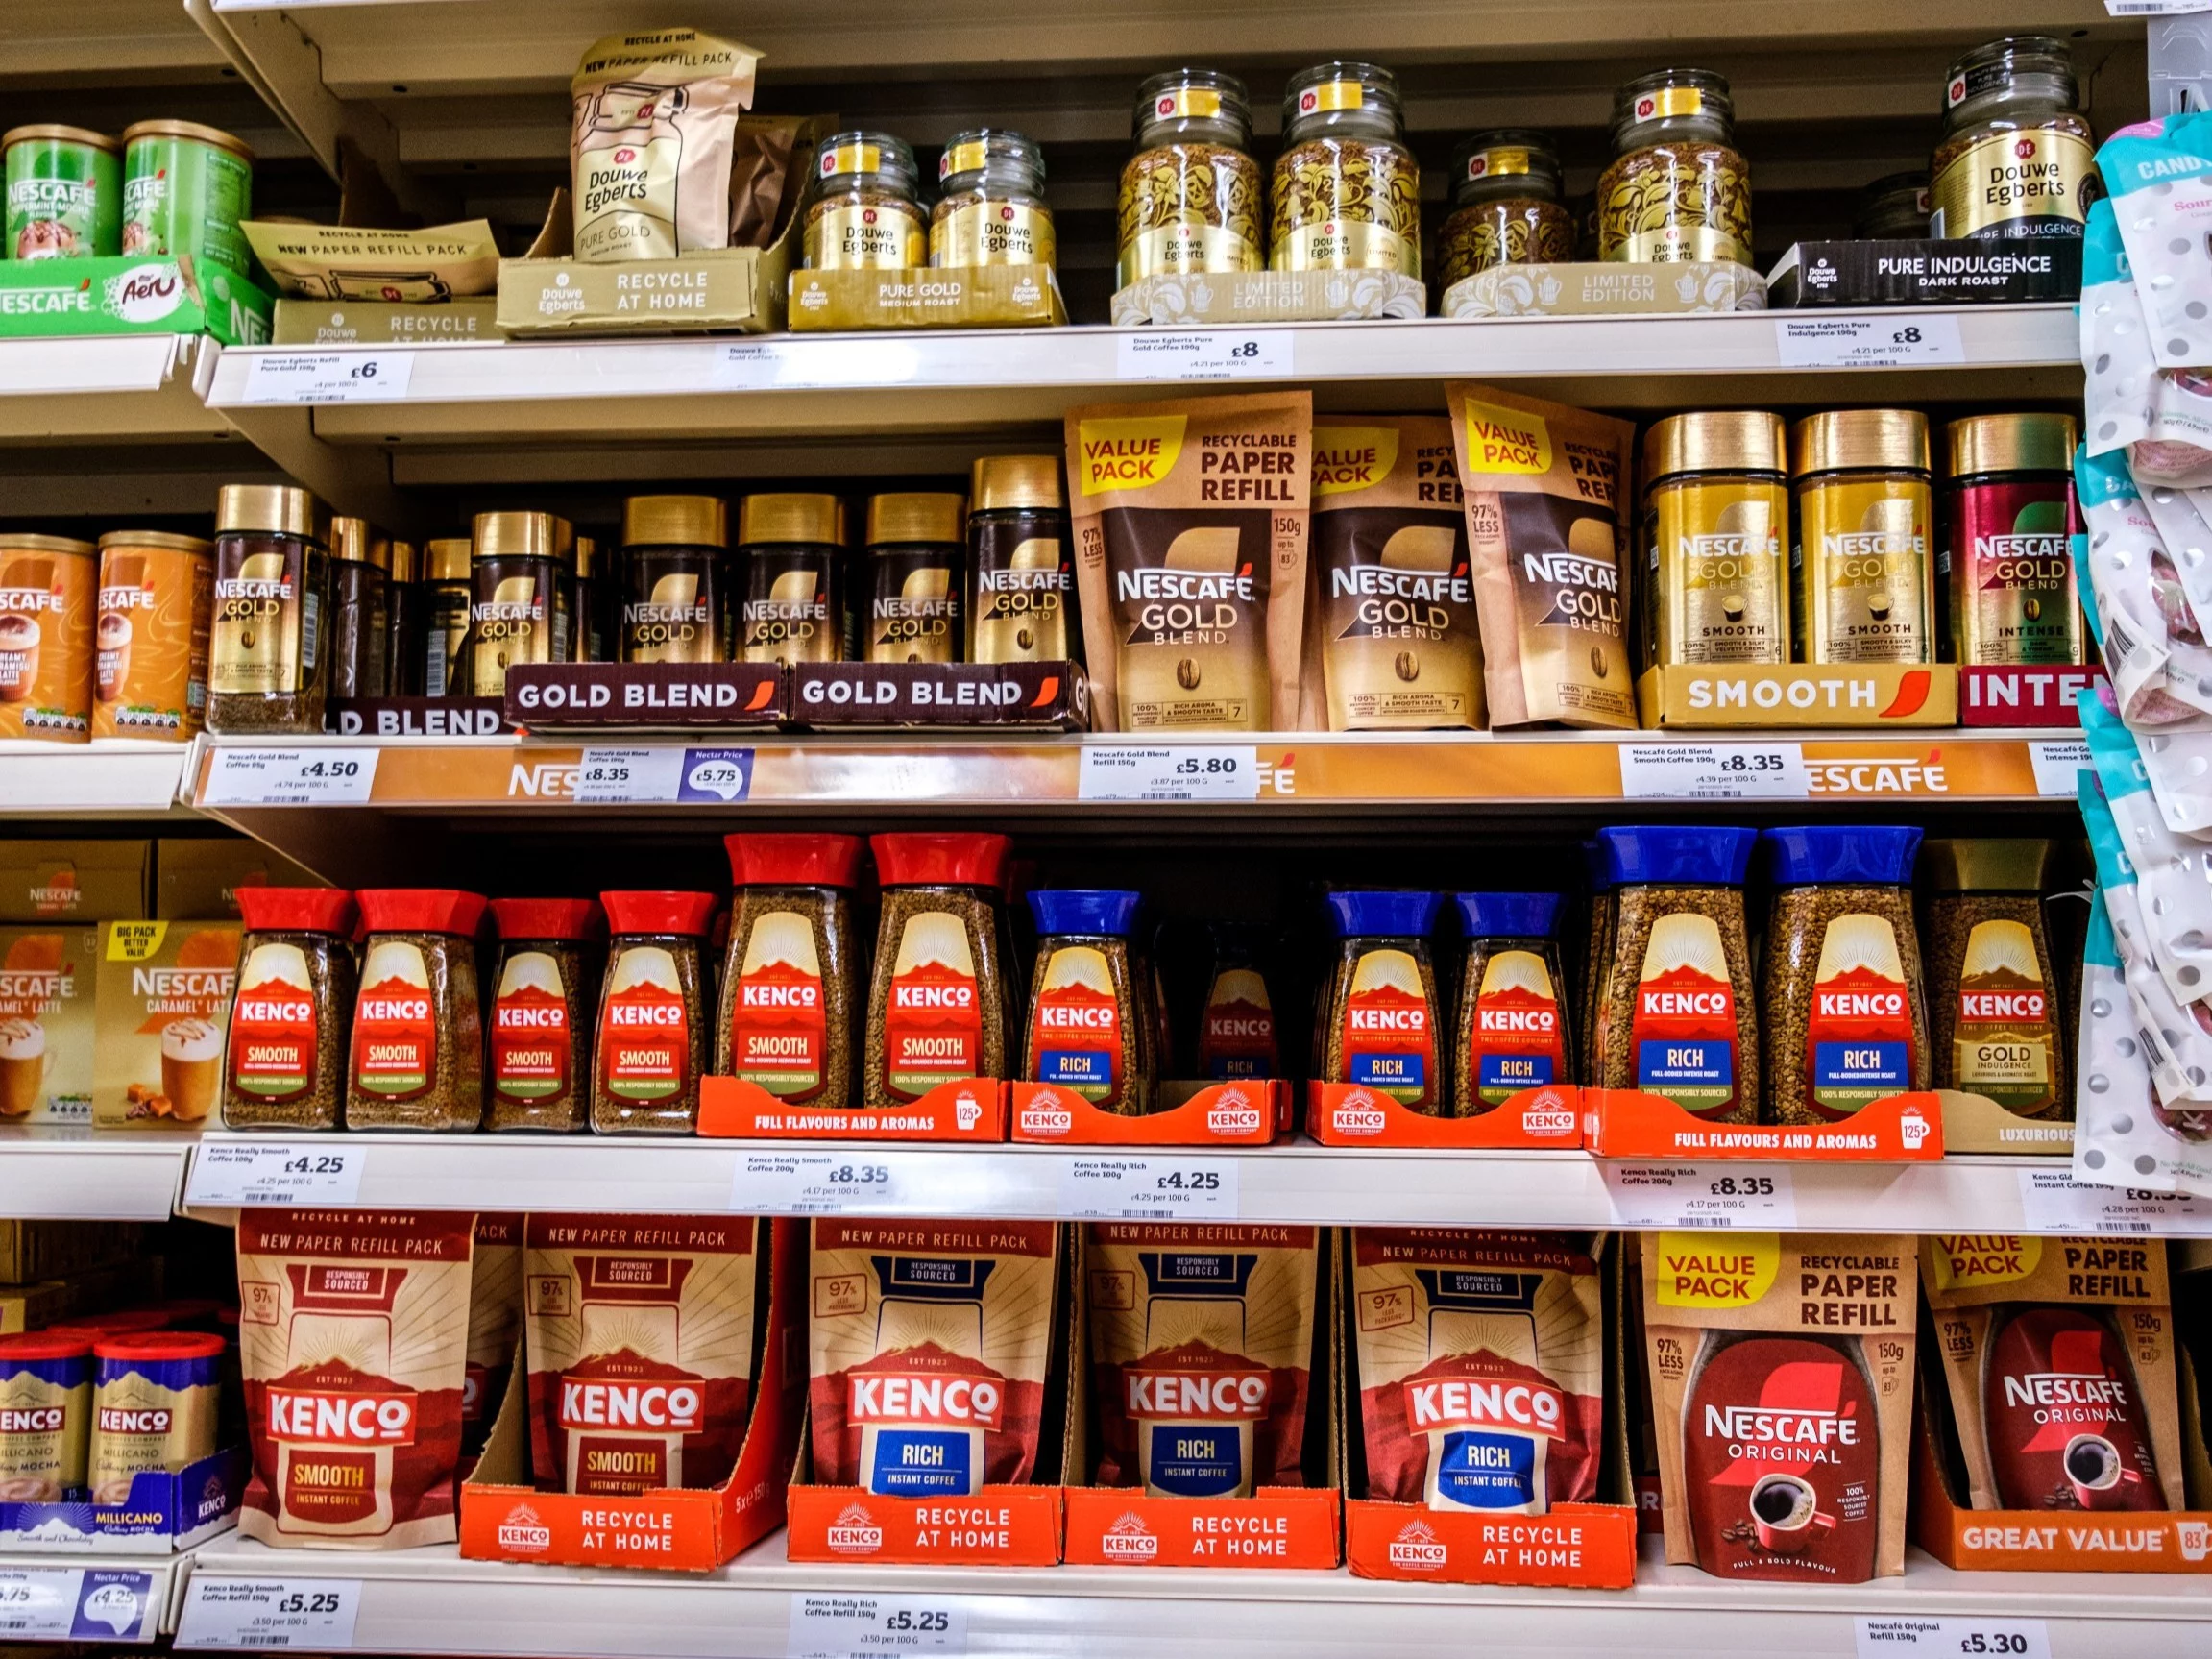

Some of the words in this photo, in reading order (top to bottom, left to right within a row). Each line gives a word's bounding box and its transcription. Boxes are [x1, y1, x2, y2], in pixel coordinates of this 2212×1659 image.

[590, 168, 648, 189] Douwe
[1991, 161, 2059, 183] Douwe
[8, 179, 96, 205] NESCAFÉ
[585, 183, 646, 213] Egberts
[1986, 178, 2065, 206] Egberts
[278, 244, 307, 256] NEW
[312, 245, 361, 256] PAPER
[368, 245, 421, 256] REFILL
[427, 245, 467, 256] PACK
[1879, 257, 1923, 274] PURE
[1931, 256, 2051, 274] INDULGENCE
[617, 272, 708, 289] RECYCLE
[1585, 276, 1653, 288] LIMITED
[1919, 277, 1957, 286] DARK
[1962, 276, 2008, 286] ROAST
[880, 284, 914, 298] PURE
[920, 283, 961, 298] GOLD
[1582, 288, 1655, 302] EDITION
[617, 295, 641, 310] AT
[649, 293, 707, 309] HOME
[880, 299, 920, 307] MEDIUM
[925, 298, 960, 306] ROAST
[1788, 329, 1835, 338] Indulgence
[1819, 323, 1849, 331] Egberts
[1893, 327, 1922, 344] £8
[1231, 342, 1259, 357] £8
[351, 361, 377, 379] £6
[1085, 438, 1162, 459] VALUE
[1202, 434, 1296, 448] RECYCLABLE
[1092, 459, 1155, 483] PACK
[1201, 452, 1295, 475] PAPER
[1202, 479, 1295, 501] REFILL
[1274, 517, 1300, 535] 150g
[1679, 526, 1781, 558] NESCAFÉ
[980, 562, 1071, 593] NESCAFÉ
[1996, 560, 2066, 580] GOLD
[215, 574, 293, 599] NESCAFÉ
[1117, 563, 1255, 602] NESCAFÉ
[2005, 580, 2058, 591] BLEND
[225, 599, 280, 617] GOLD
[995, 593, 1059, 611] GOLD
[1004, 611, 1051, 621] BLEND
[1141, 604, 1238, 629] GOLD
[1154, 631, 1227, 646] BLEND
[1703, 625, 1765, 637] SMOOTH
[1999, 626, 2064, 637] INTENSE
[518, 684, 611, 708] GOLD
[625, 683, 738, 707] BLEND
[1689, 679, 1876, 708] SMOOTH
[696, 750, 721, 759] Nectar
[723, 750, 743, 759] Price
[1093, 749, 1125, 758] Nescafé
[1633, 747, 1665, 756] Nescafé
[1688, 747, 1713, 756] Blend
[1093, 758, 1115, 767] Refill
[1117, 759, 1136, 768] 150g
[1176, 758, 1237, 774] £5.80
[1634, 756, 1665, 765] Smooth
[1666, 756, 1693, 765] Coffee
[1695, 757, 1716, 766] 190g
[1721, 755, 1784, 771] £8.35
[301, 762, 359, 778] £4.50
[585, 768, 629, 781] £8.35
[696, 769, 736, 782] £5.75
[1171, 779, 1184, 788] per
[117, 926, 132, 938] BIG
[134, 926, 156, 938] PACK
[124, 939, 148, 947] BETTER
[126, 948, 146, 958] VALUE
[743, 986, 816, 1007] KENCO
[1644, 993, 1726, 1014] KENCO
[241, 1002, 311, 1022] KENCO
[1963, 995, 2044, 1017] KENCO
[1042, 1007, 1113, 1028] KENCO
[1211, 1019, 1271, 1037] KENCO
[248, 1046, 298, 1061] SMOOTH
[748, 1037, 808, 1055] SMOOTH
[1978, 1046, 2030, 1061] GOLD
[1060, 1057, 1091, 1073] RICH
[1667, 1049, 1704, 1068] RICH
[756, 1074, 790, 1083] RESPONSIBLY
[755, 1115, 783, 1130] FULL
[786, 1115, 848, 1131] FLAVOURS
[851, 1116, 877, 1130] AND
[881, 1117, 934, 1131] AROMAS
[959, 1108, 974, 1121] 125
[1211, 1112, 1256, 1126] KENCO
[1999, 1128, 2076, 1141] LUXURIOUS
[285, 1157, 344, 1173] £4.25
[1074, 1161, 1099, 1170] Kenco
[1100, 1161, 1127, 1171] Really
[829, 1165, 889, 1183] £8.35
[1074, 1170, 1100, 1179] Coffee
[1102, 1170, 1122, 1180] 100g
[1157, 1172, 1220, 1190] £4.25
[1711, 1177, 1774, 1196] £8.35
[2035, 1182, 2064, 1190] Instant
[2066, 1182, 2093, 1190] Coffee
[260, 1233, 291, 1249] NEW
[296, 1235, 343, 1252] PAPER
[351, 1237, 398, 1254] REFILL
[405, 1239, 443, 1255] PACK
[911, 1261, 956, 1271] RESPONSIBLY
[1667, 1256, 1755, 1276] VALUE
[1801, 1255, 1900, 1270] RECYCLABLE
[2066, 1248, 2149, 1272] PAPER
[324, 1279, 369, 1291] SOURCED
[1676, 1277, 1750, 1300] PACK
[2069, 1274, 2151, 1298] REFILL
[854, 1378, 999, 1422] KENCO
[1412, 1381, 1559, 1431] KENCO
[100, 1411, 169, 1431] KENCO
[270, 1394, 411, 1439] KENCO
[1705, 1401, 1860, 1446] NESCAFÉ
[902, 1444, 944, 1466] RICH
[1728, 1444, 1842, 1464] ORIGINAL
[294, 1463, 364, 1487] SMOOTH
[887, 1474, 921, 1485] INSTANT
[924, 1475, 956, 1486] COFFEE
[96, 1512, 162, 1525] MILLICANO
[916, 1508, 1010, 1525] RECYCLE
[916, 1530, 941, 1547] AT
[950, 1531, 1009, 1548] HOME
[1962, 1527, 2058, 1550] GREAT
[2067, 1528, 2164, 1552] VALUE
[1768, 1557, 1791, 1566] BOLD
[1795, 1558, 1837, 1574] FLAVOUR
[94, 1573, 119, 1583] Nectar
[121, 1574, 141, 1584] Price
[95, 1590, 134, 1606] £4.25
[280, 1593, 339, 1613] £5.25
[806, 1599, 830, 1608] Kenco
[832, 1599, 858, 1609] Really
[860, 1600, 878, 1609] Rich
[805, 1608, 831, 1617] Coffee
[833, 1609, 855, 1618] Refill
[857, 1610, 876, 1620] 150g
[887, 1611, 949, 1632] £5.25
[1868, 1622, 1903, 1631] Nescafé
[1905, 1622, 1940, 1633] Original
[1870, 1632, 1895, 1641] Refill
[1896, 1632, 1917, 1643] 150g
[1961, 1633, 2028, 1654] £5.30
